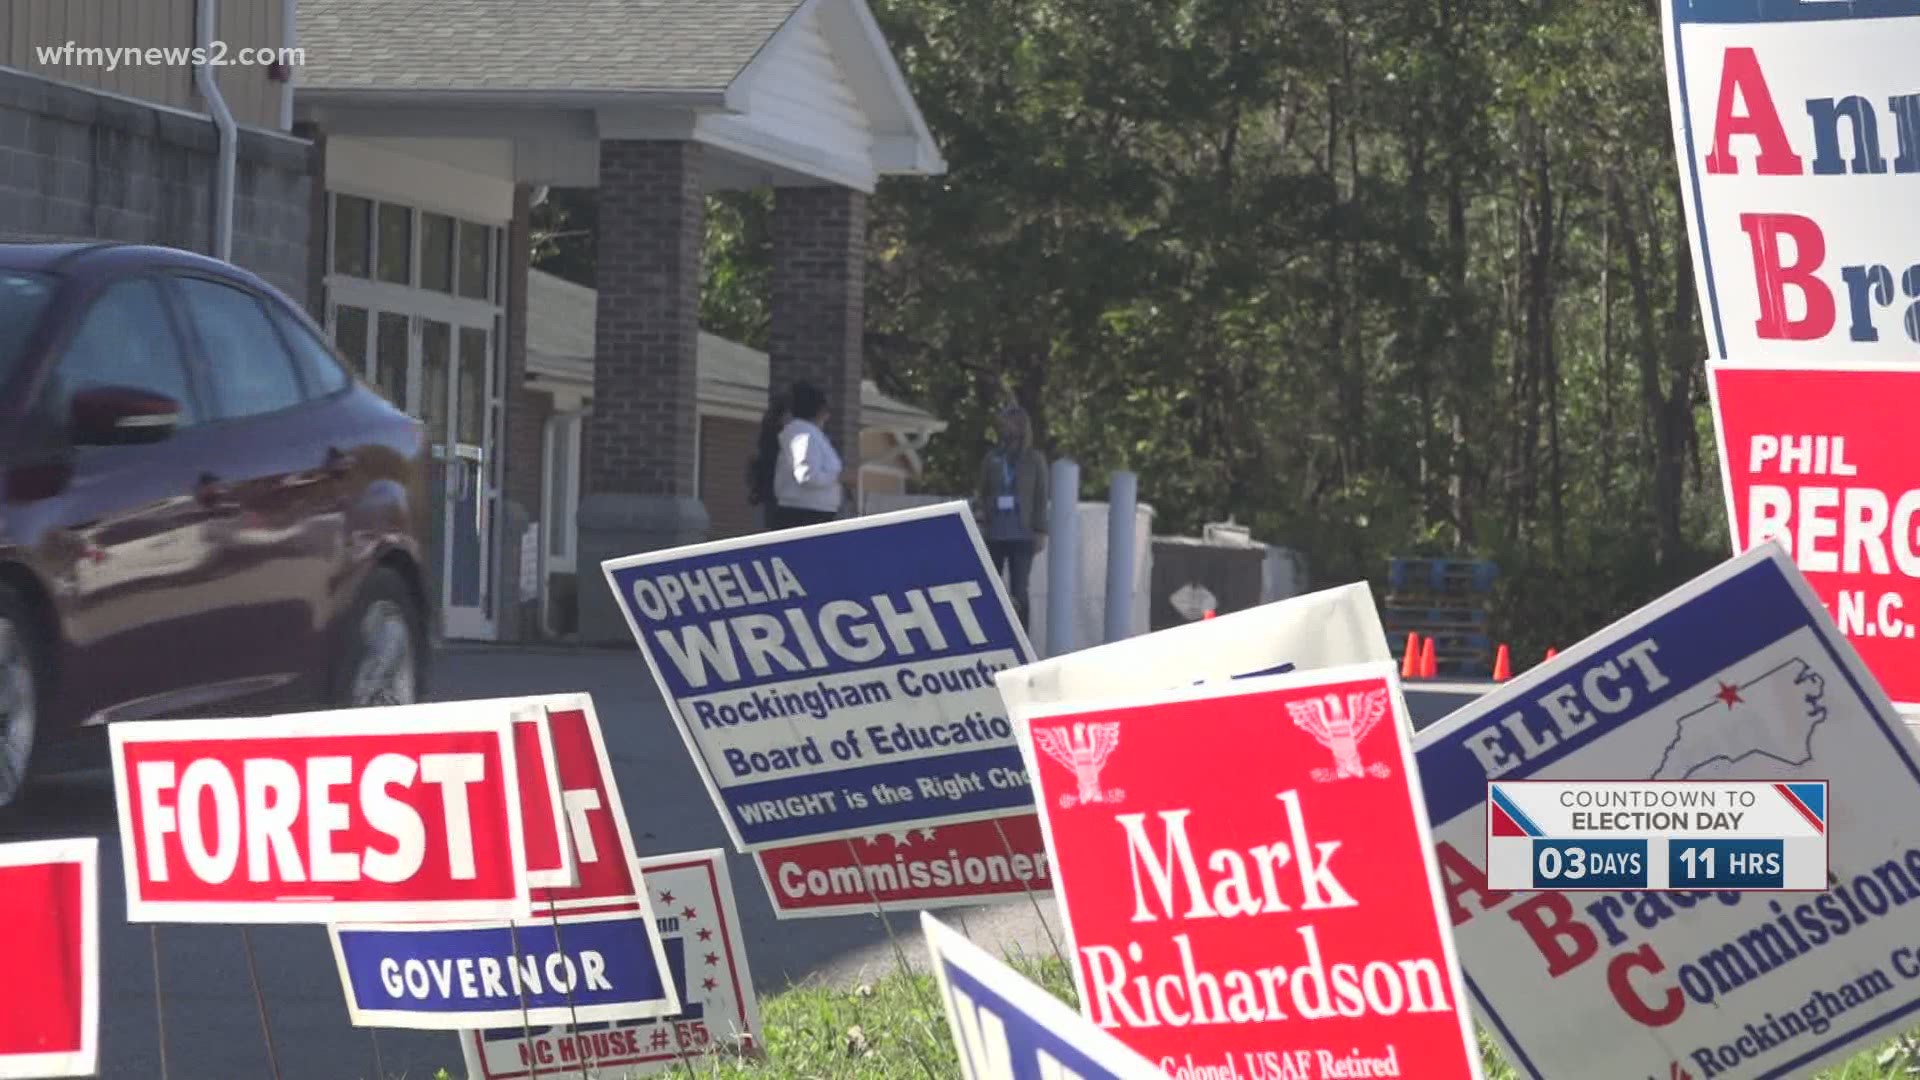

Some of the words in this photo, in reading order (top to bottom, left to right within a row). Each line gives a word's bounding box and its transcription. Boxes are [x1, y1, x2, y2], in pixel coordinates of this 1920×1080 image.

[1750, 434, 1857, 476] PHIL
[633, 557, 807, 622] OPHELIA
[1837, 589, 1916, 639] N.C.
[656, 582, 989, 688] WRIGHT
[692, 675, 893, 731] Rockingham
[896, 659, 1007, 698] Count
[1463, 638, 1672, 779] ELECT
[724, 741, 824, 778] Board
[832, 730, 863, 762] of
[137, 752, 486, 884] FOREST
[738, 789, 838, 827] WRIGHT
[841, 787, 869, 811] is
[871, 782, 916, 806] the
[916, 764, 986, 802] Right
[778, 850, 1048, 898] Commissioner
[1115, 790, 1359, 922] Mark
[380, 950, 613, 1000] GOVERNOR
[1080, 925, 1452, 1030] Richardson
[517, 1038, 556, 1066] NC
[558, 1029, 642, 1060] HOUSE
[675, 1020, 712, 1050] 65
[1691, 968, 1895, 1080] Rockingham
[1244, 1050, 1311, 1080] USAF
[1316, 1044, 1401, 1078] Retired
